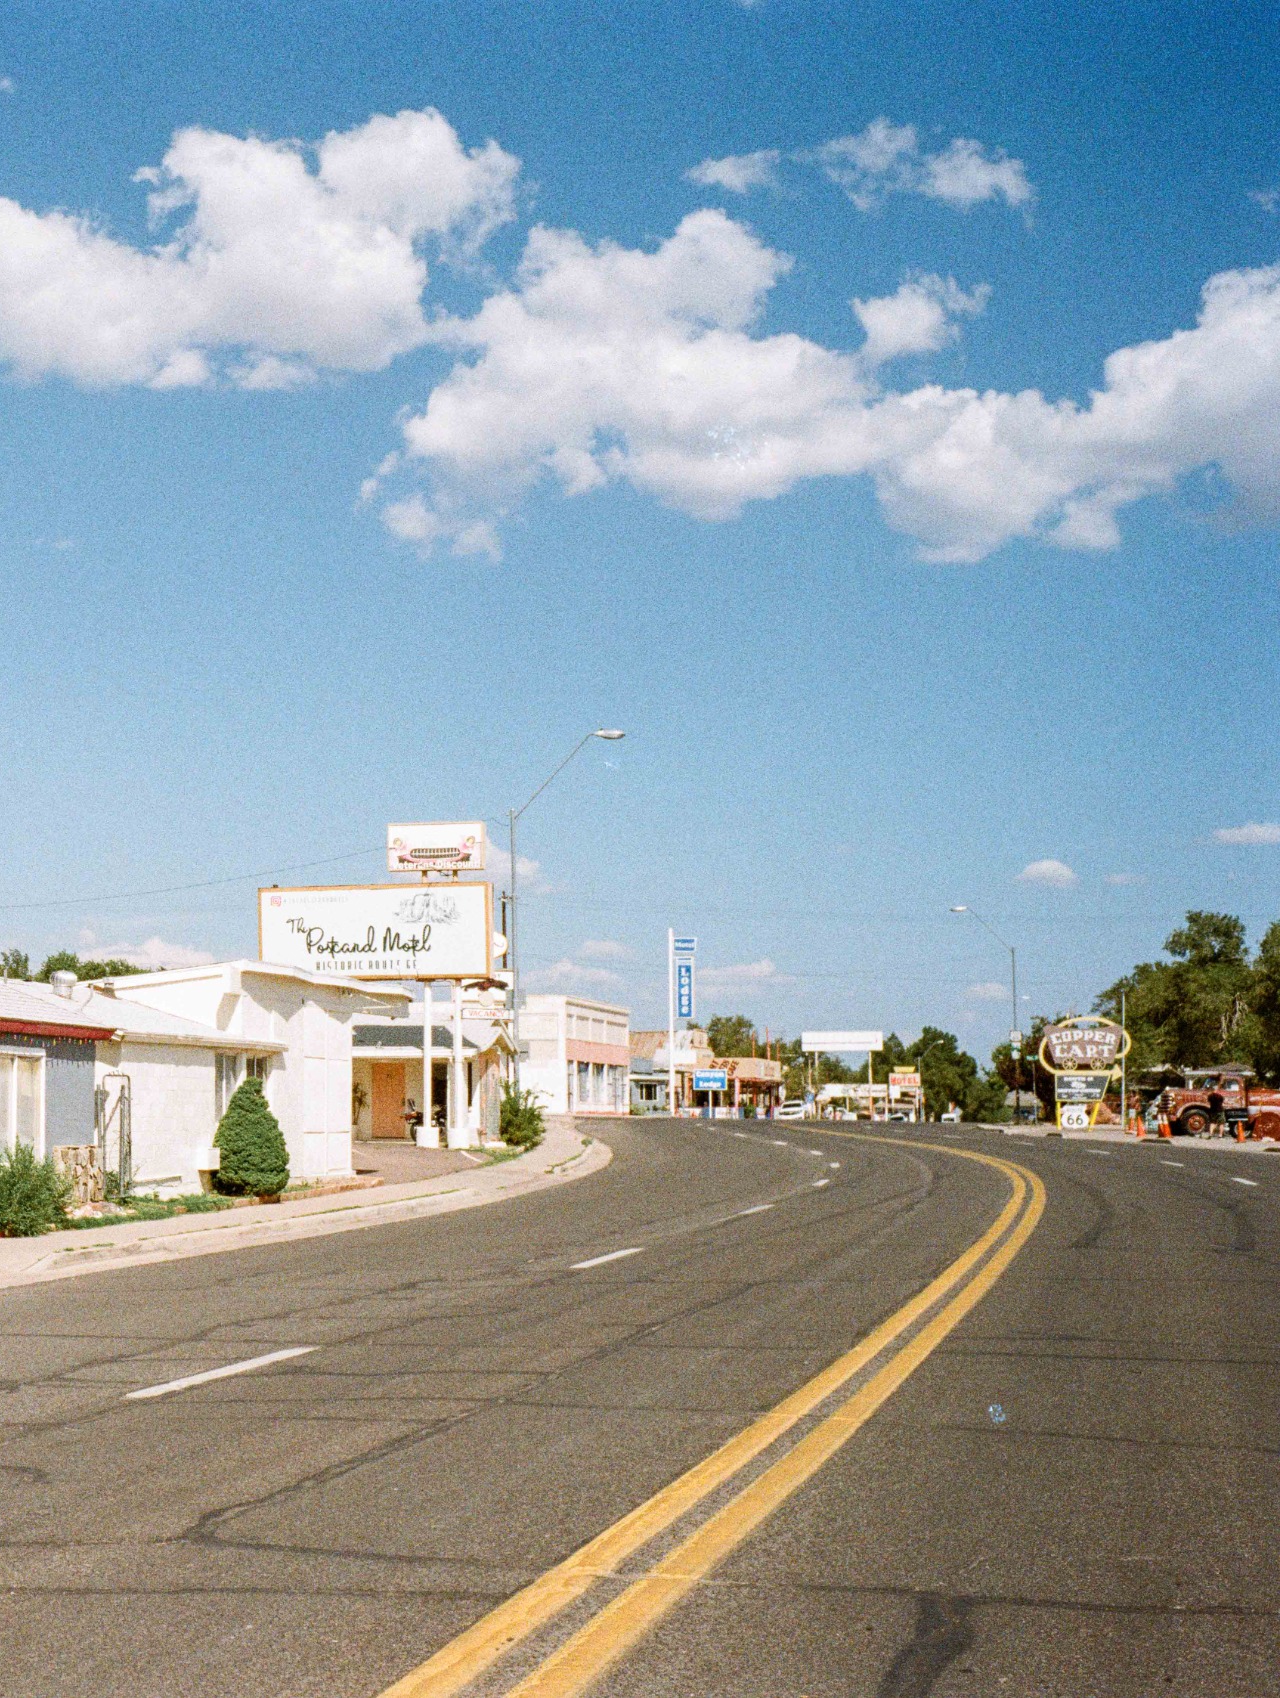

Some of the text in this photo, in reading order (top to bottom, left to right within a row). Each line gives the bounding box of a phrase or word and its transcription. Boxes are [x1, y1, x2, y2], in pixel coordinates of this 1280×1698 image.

[286, 917, 307, 934] The
[306, 924, 431, 958] Postcard Motel
[316, 960, 363, 970] HISTORIC
[1049, 1029, 1116, 1045] COPPER
[1055, 1044, 1114, 1058] CART
[890, 1076, 918, 1086] MOTEL
[1067, 1114, 1084, 1126] 66
